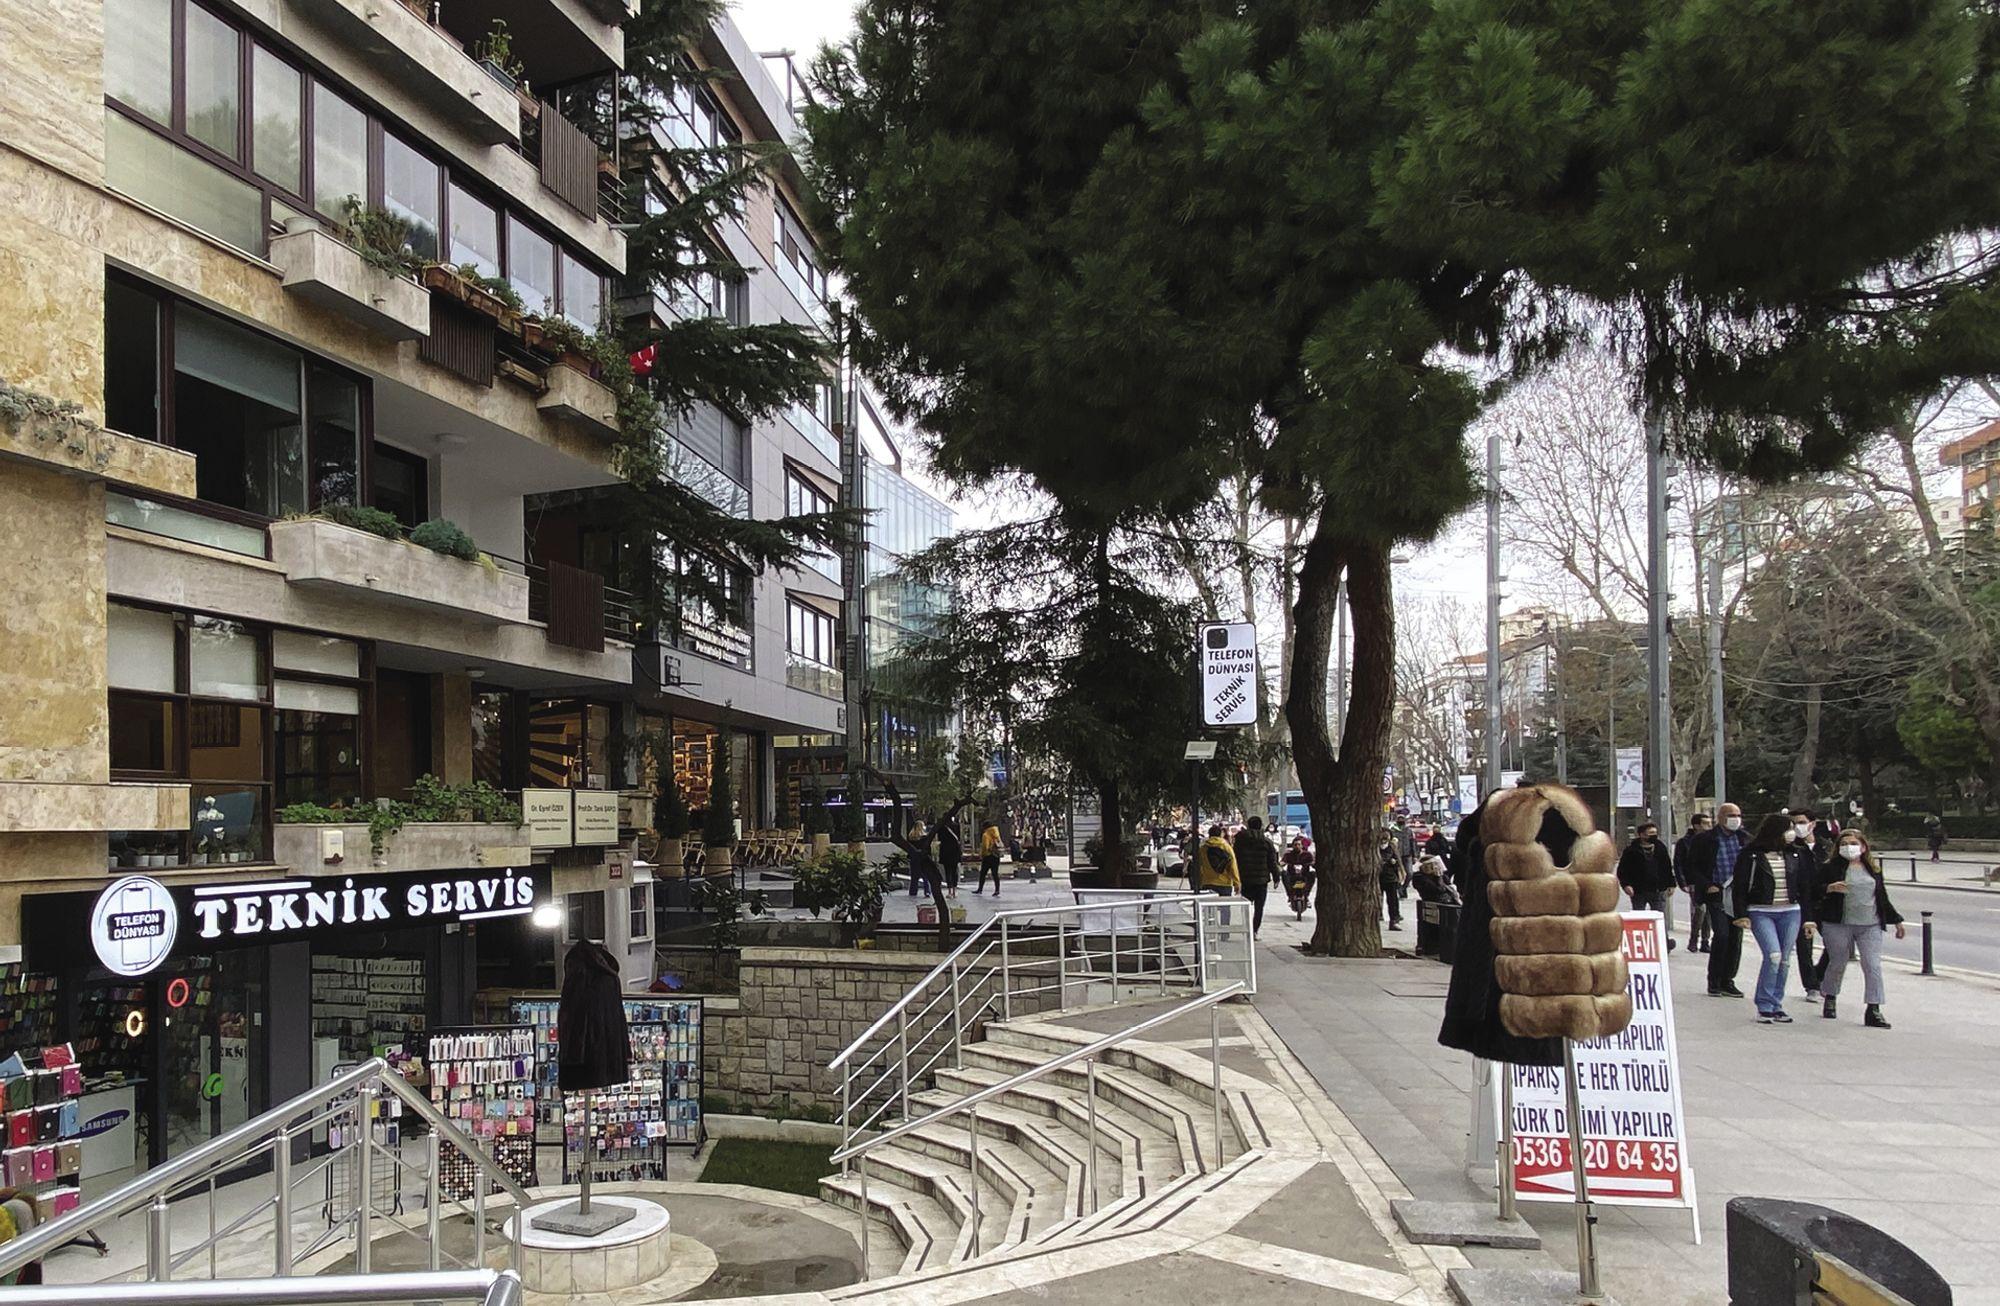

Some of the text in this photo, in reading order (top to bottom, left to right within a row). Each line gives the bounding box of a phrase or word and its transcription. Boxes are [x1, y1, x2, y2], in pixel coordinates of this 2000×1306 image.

[1208, 649, 1253, 661] TELEFON
[1208, 663, 1254, 675] DÜNYASI
[1213, 675, 1246, 705] TEKNİK
[1215, 692, 1246, 723] SERVİS
[194, 868, 534, 938] TEKNİK SERVİS
[114, 913, 160, 927] TELEFON
[114, 925, 160, 939] DÜNYASI
[1632, 923, 1656, 959] EVİ
[1628, 973, 1661, 1010] RK
[1591, 1062, 1620, 1091] HER
[1622, 1058, 1669, 1093] TÜRLÜ
[81, 1114, 126, 1132] SAMSUNG
[1611, 1110, 1674, 1137] YAPILIR
[1616, 1141, 1644, 1171] 64
[1650, 1143, 1678, 1173] 35
